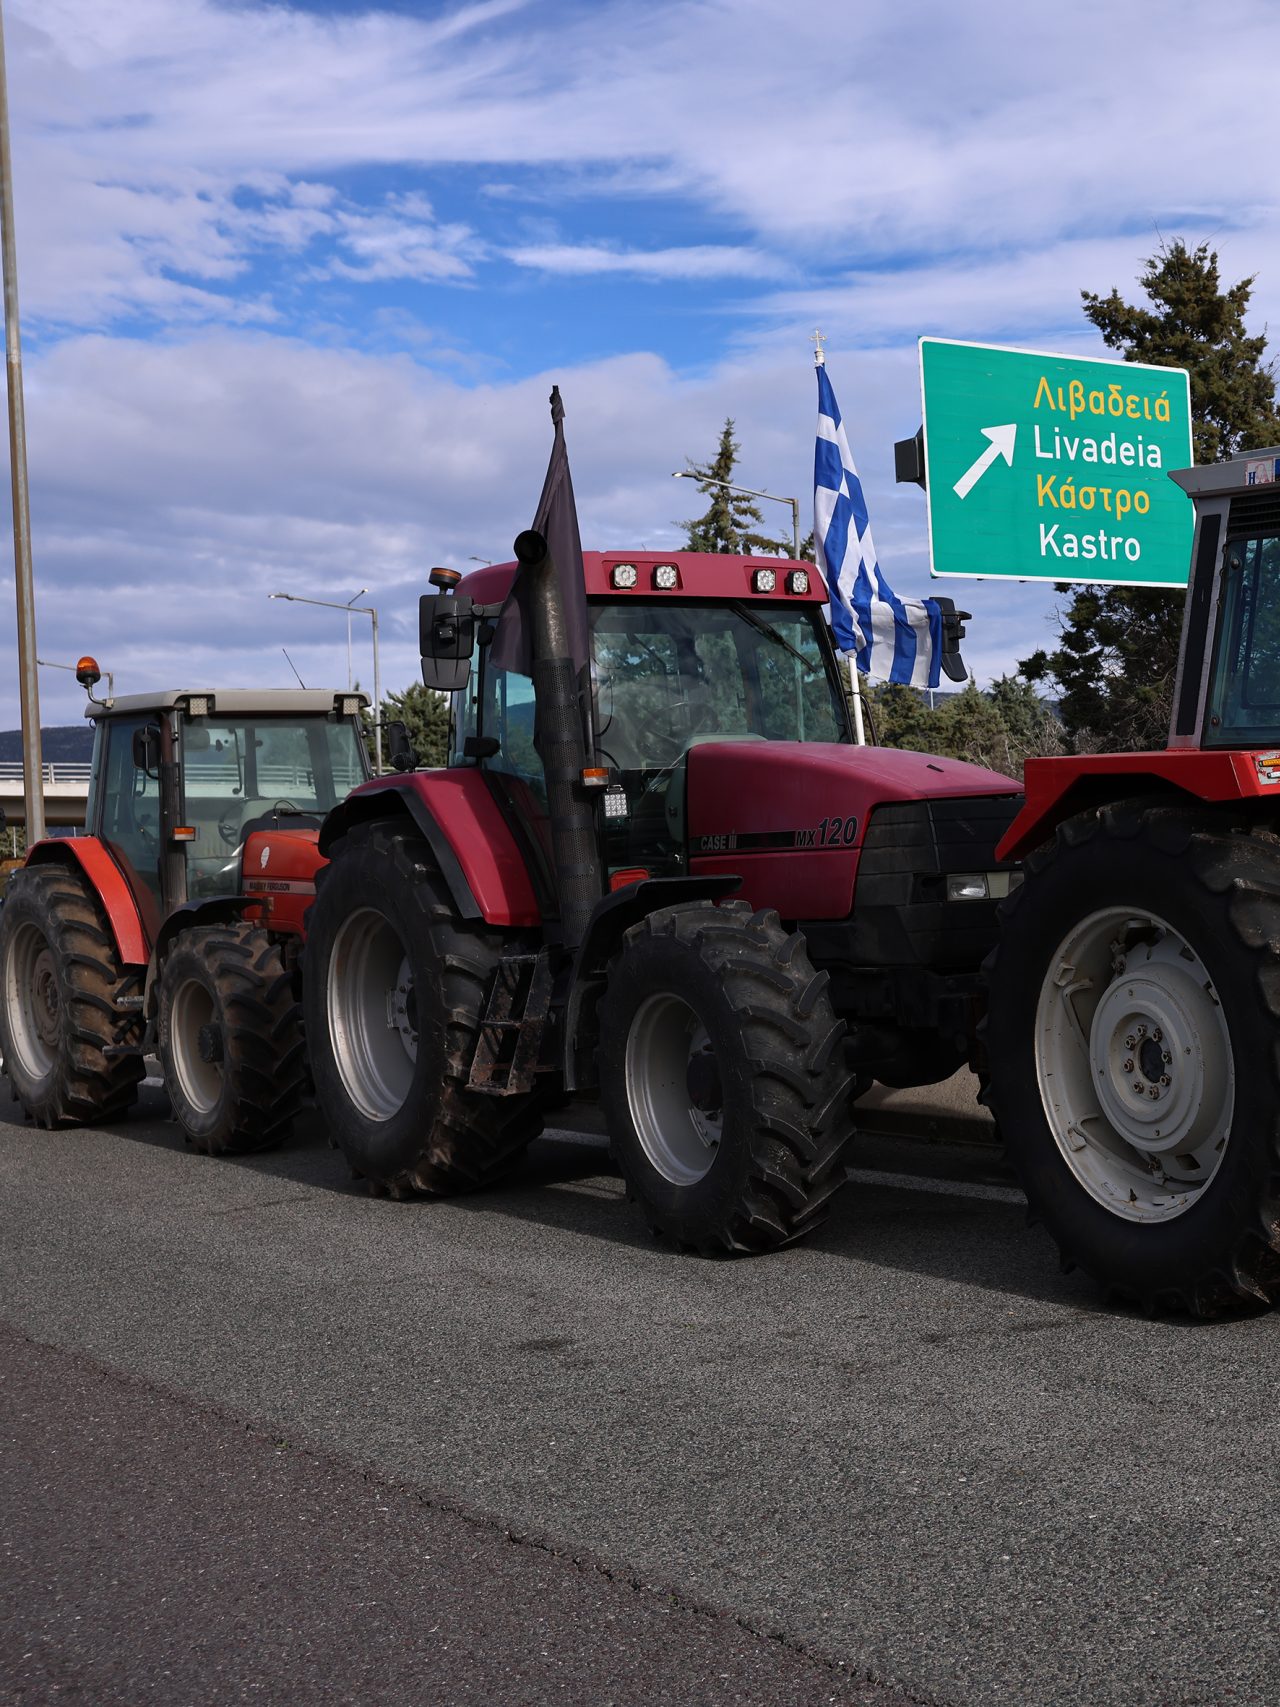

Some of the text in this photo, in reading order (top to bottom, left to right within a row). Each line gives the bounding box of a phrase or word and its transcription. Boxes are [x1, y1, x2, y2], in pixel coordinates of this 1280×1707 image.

[1033, 376, 1171, 422] Λιβαδειά
[1034, 424, 1162, 468] Livadeia
[1036, 474, 1150, 520] Κάστρο
[1039, 523, 1141, 561] Kastro
[700, 835, 727, 850] CASE
